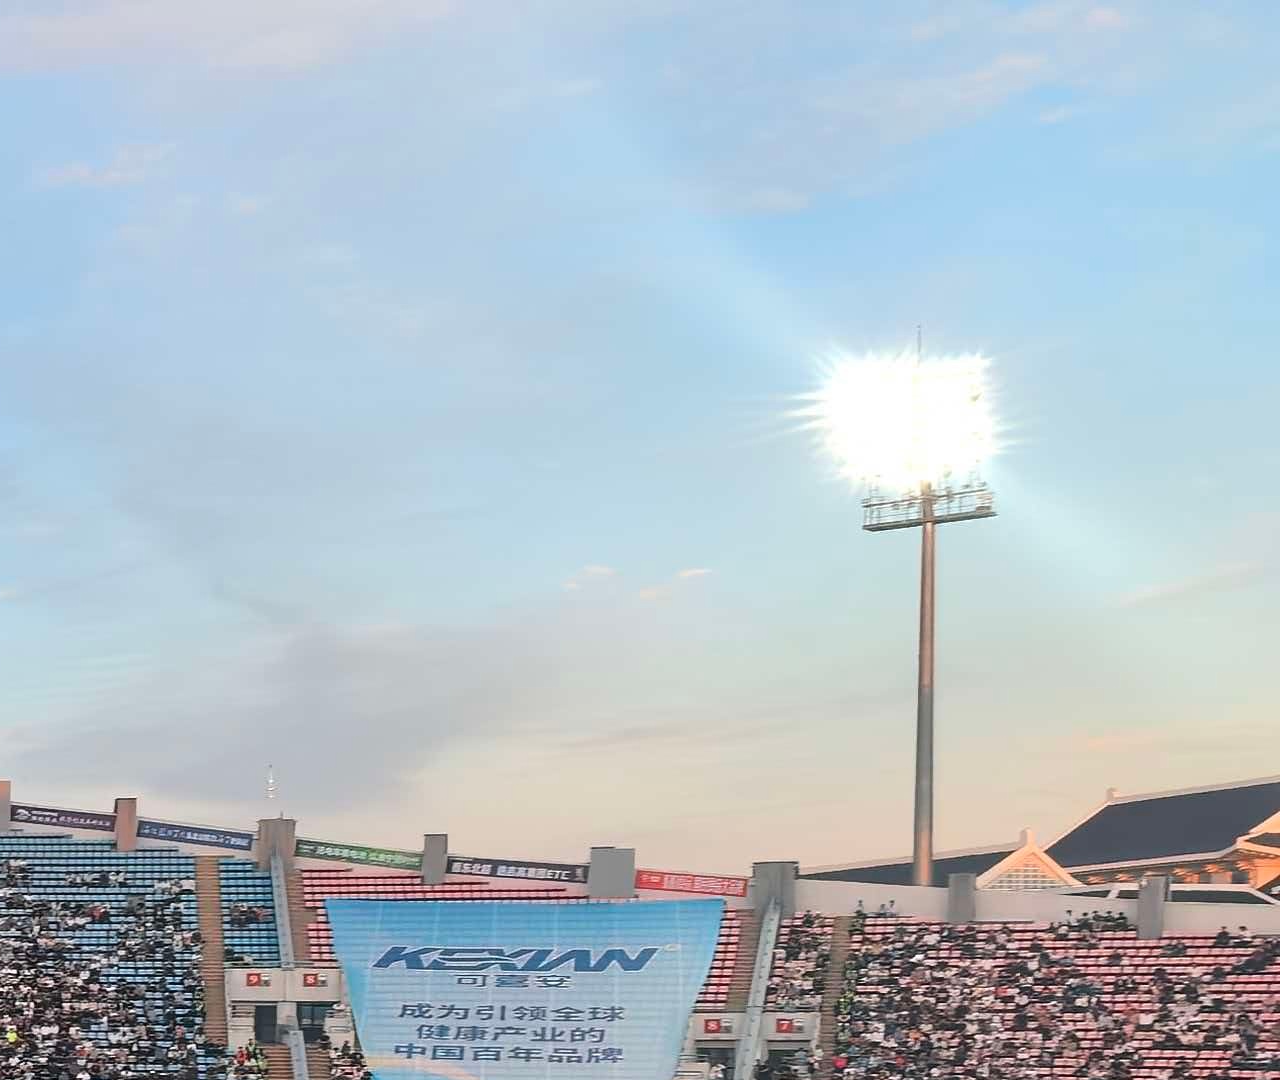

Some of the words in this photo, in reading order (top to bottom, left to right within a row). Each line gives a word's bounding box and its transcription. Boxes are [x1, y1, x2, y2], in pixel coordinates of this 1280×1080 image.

[398, 1003, 625, 1022] 成为引领全球
[416, 1025, 606, 1043] 健康产业的
[394, 1044, 625, 1063] 中国百年品牌
